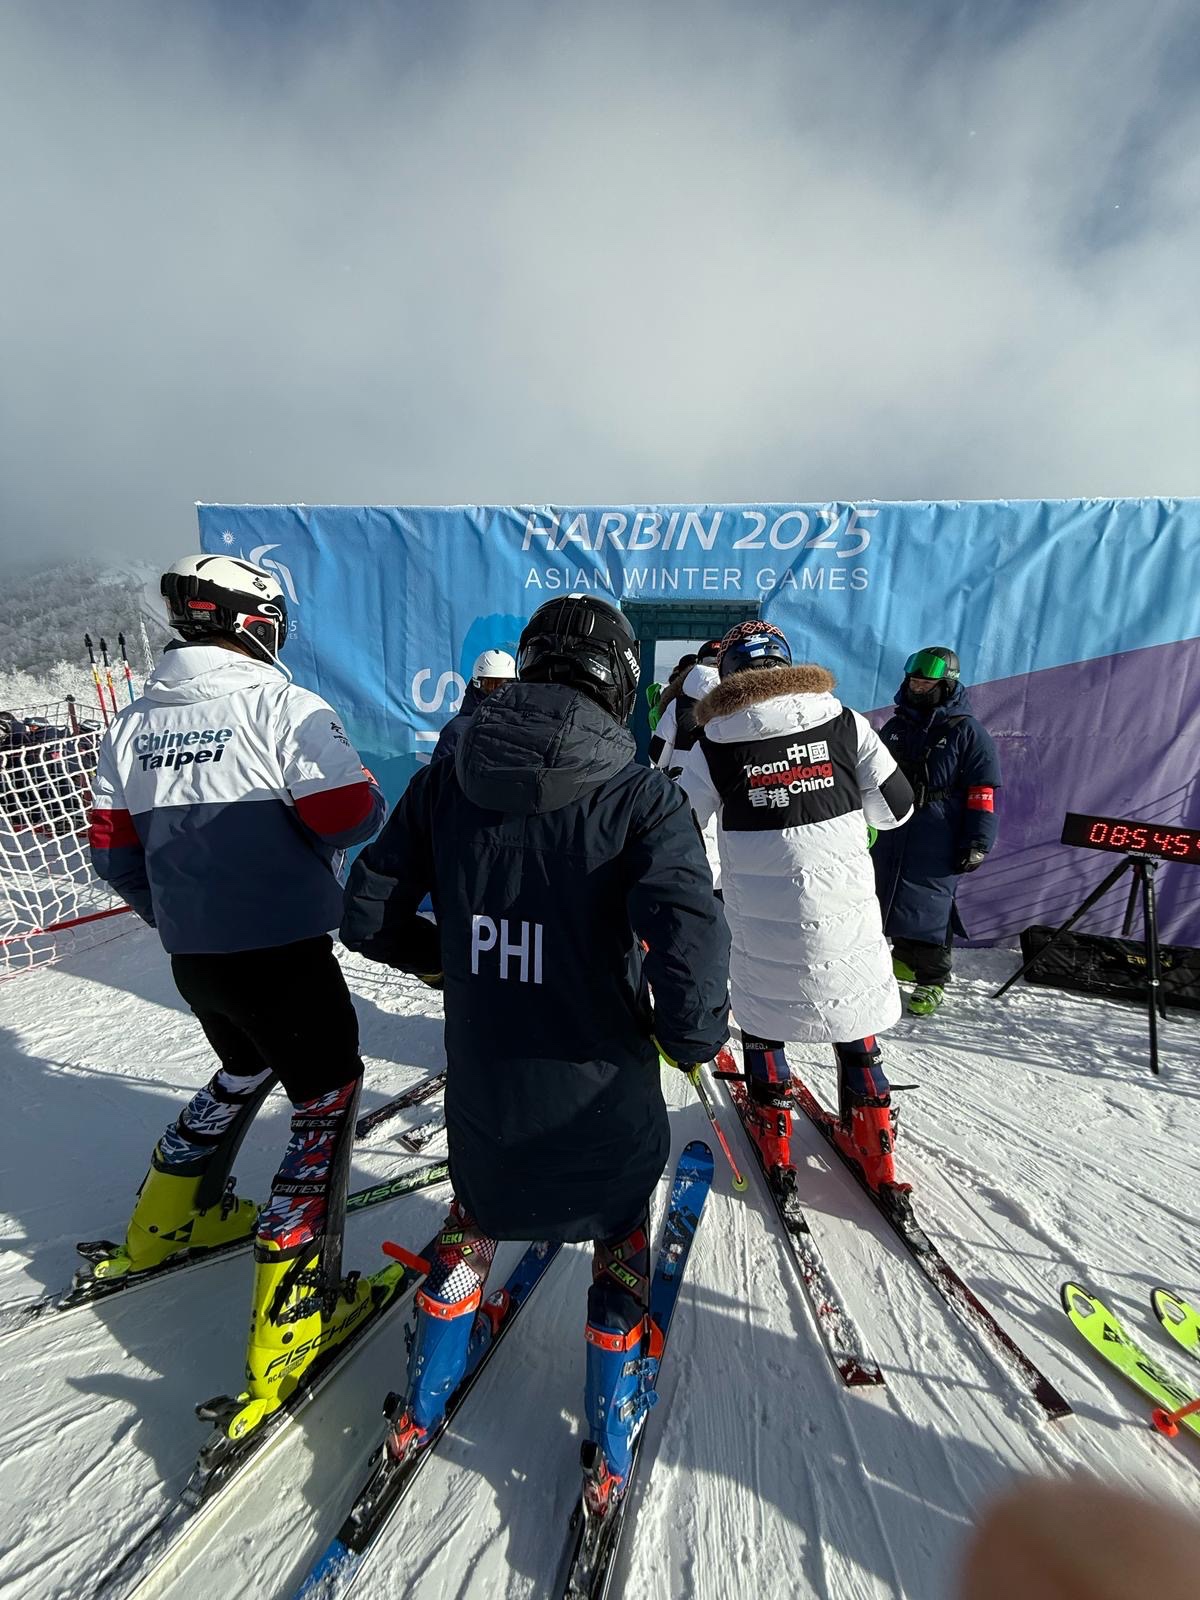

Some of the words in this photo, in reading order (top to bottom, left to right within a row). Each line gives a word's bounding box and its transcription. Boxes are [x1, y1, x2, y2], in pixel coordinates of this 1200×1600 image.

[521, 511, 724, 551] HARBIN
[732, 509, 880, 559] 2025
[524, 567, 612, 590] ASIAN
[623, 567, 742, 591] WINTER
[756, 567, 869, 591] GAMES
[133, 728, 233, 754] Chinese
[786, 740, 830, 765] 中國
[138, 743, 225, 772] Taipei
[743, 759, 790, 778] Team
[748, 786, 790, 809] 香港
[788, 775, 835, 795] China
[1089, 822, 1200, 856] 08:54:5
[471, 913, 543, 985] PHI
[346, 1164, 448, 1206] FISCHE
[441, 1232, 464, 1245] LEKI
[608, 1261, 638, 1288] LEKI
[263, 1296, 370, 1378] FISCHER
